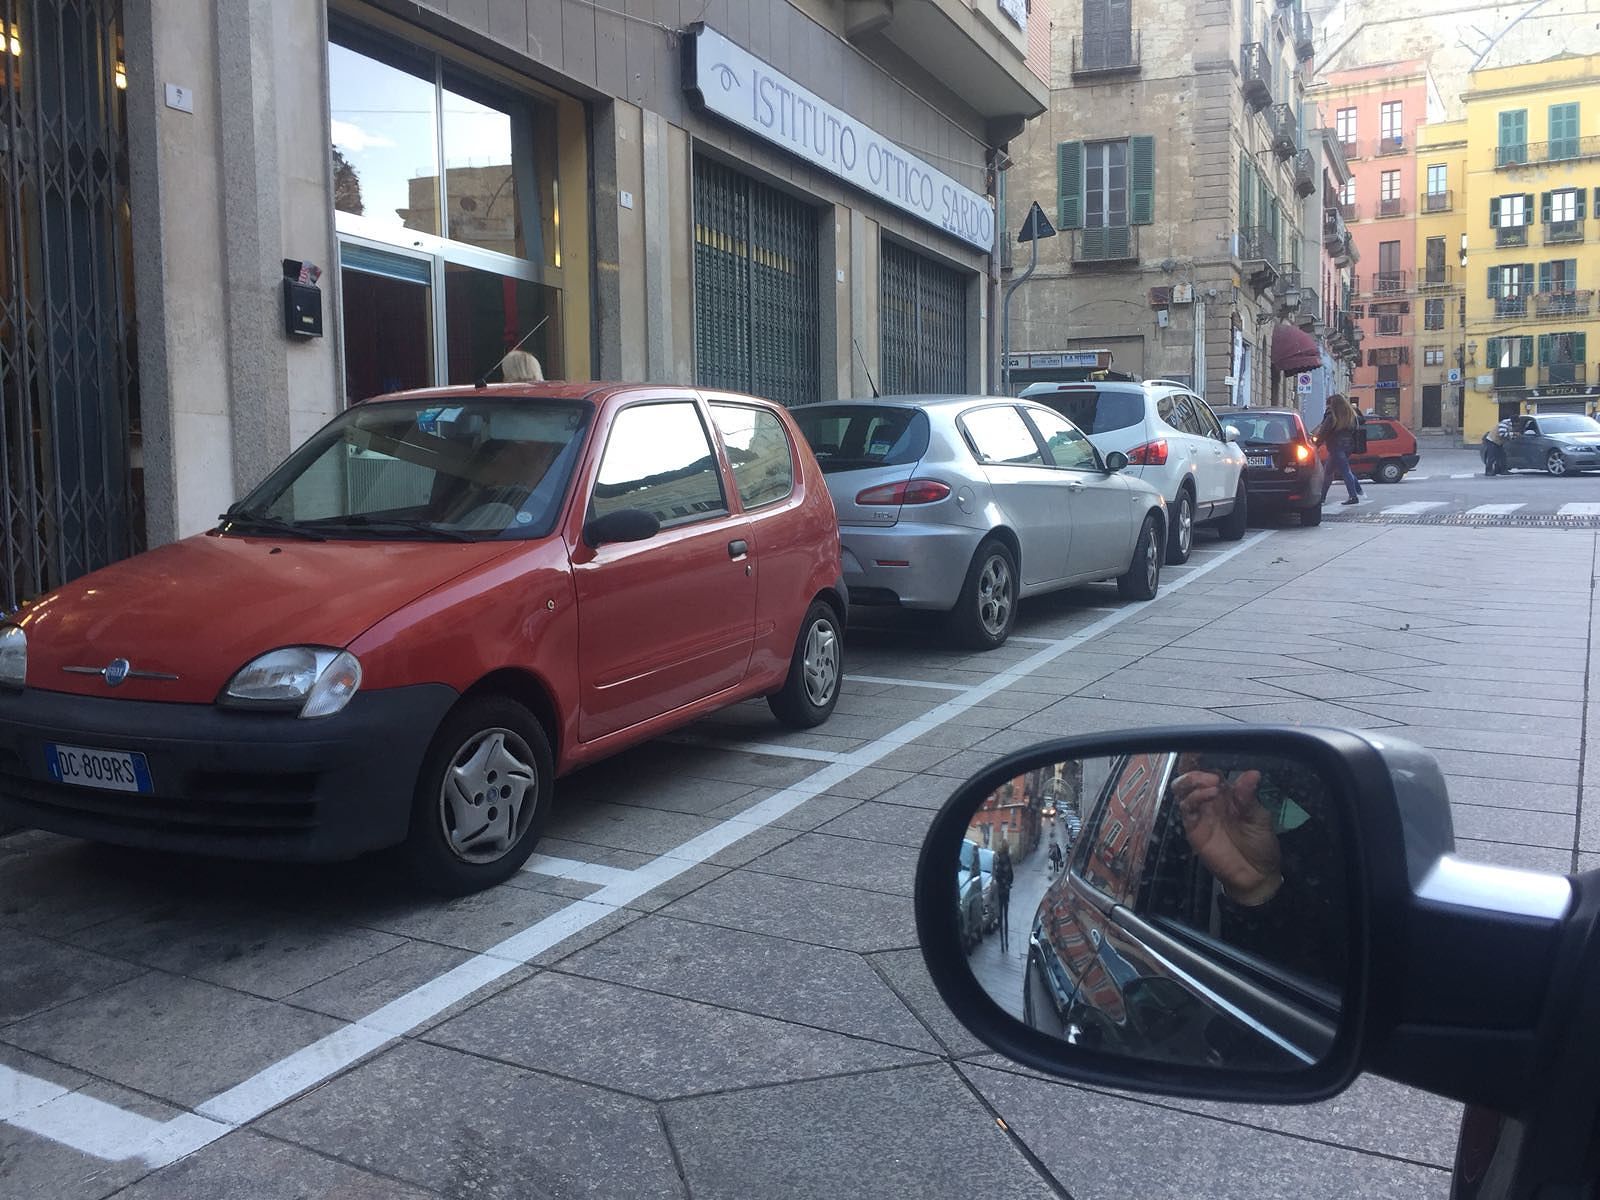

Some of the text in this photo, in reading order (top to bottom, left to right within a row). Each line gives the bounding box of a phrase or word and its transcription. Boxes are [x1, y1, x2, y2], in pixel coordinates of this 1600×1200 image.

[752, 68, 991, 242] ISTITUTO OTTICO SARDO
[83, 752, 135, 784] 809RS
